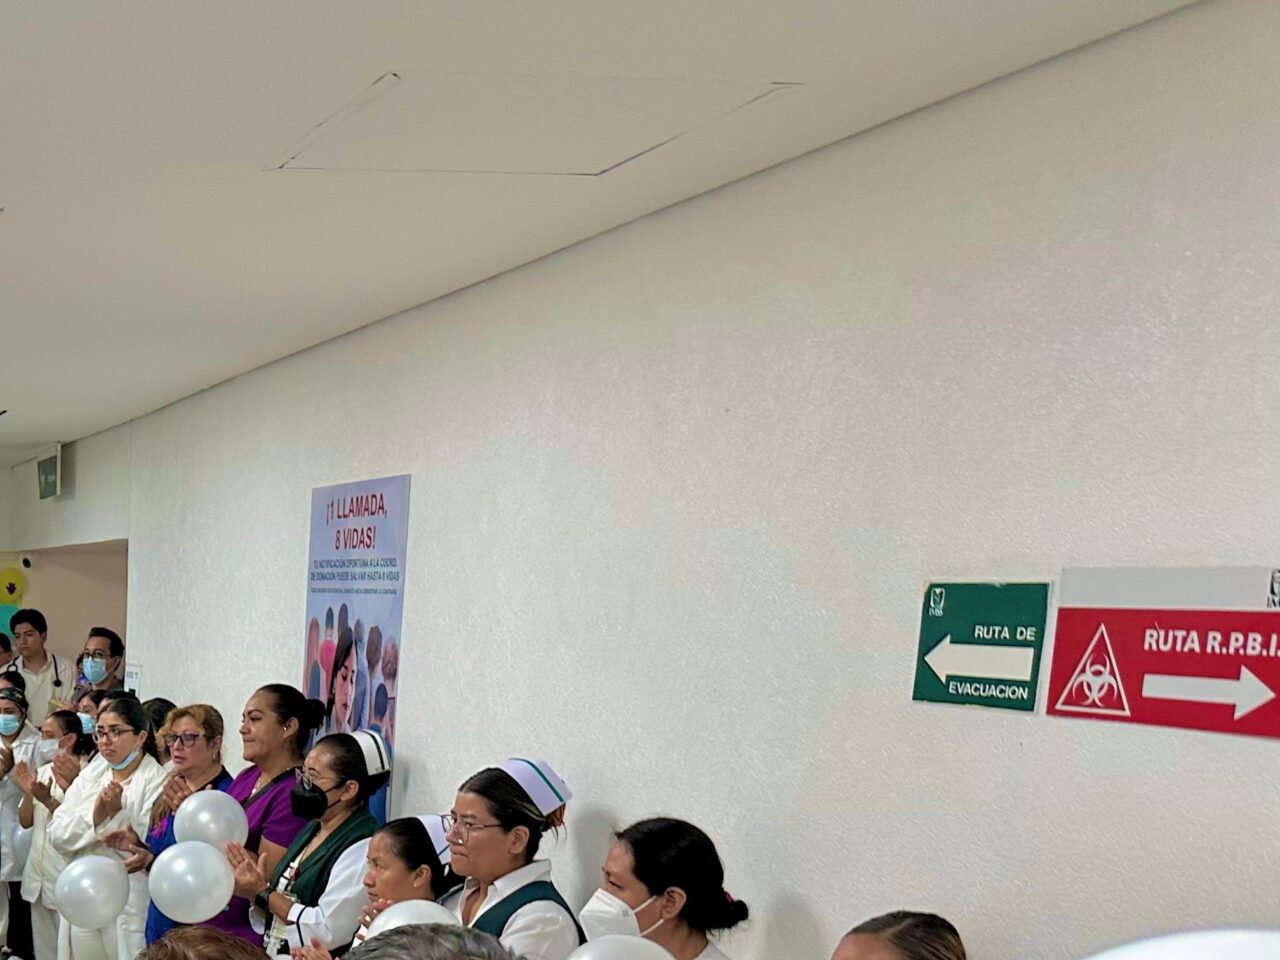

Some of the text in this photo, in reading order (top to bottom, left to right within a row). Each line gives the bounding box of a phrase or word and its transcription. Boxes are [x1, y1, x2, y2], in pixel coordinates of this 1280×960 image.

[337, 492, 388, 519] LLAMADA,
[335, 525, 377, 550] 8 VIDAS!
[974, 624, 1037, 641] RUTA DE
[1143, 628, 1200, 653] RUTA
[949, 680, 1029, 700] EVACUACION
